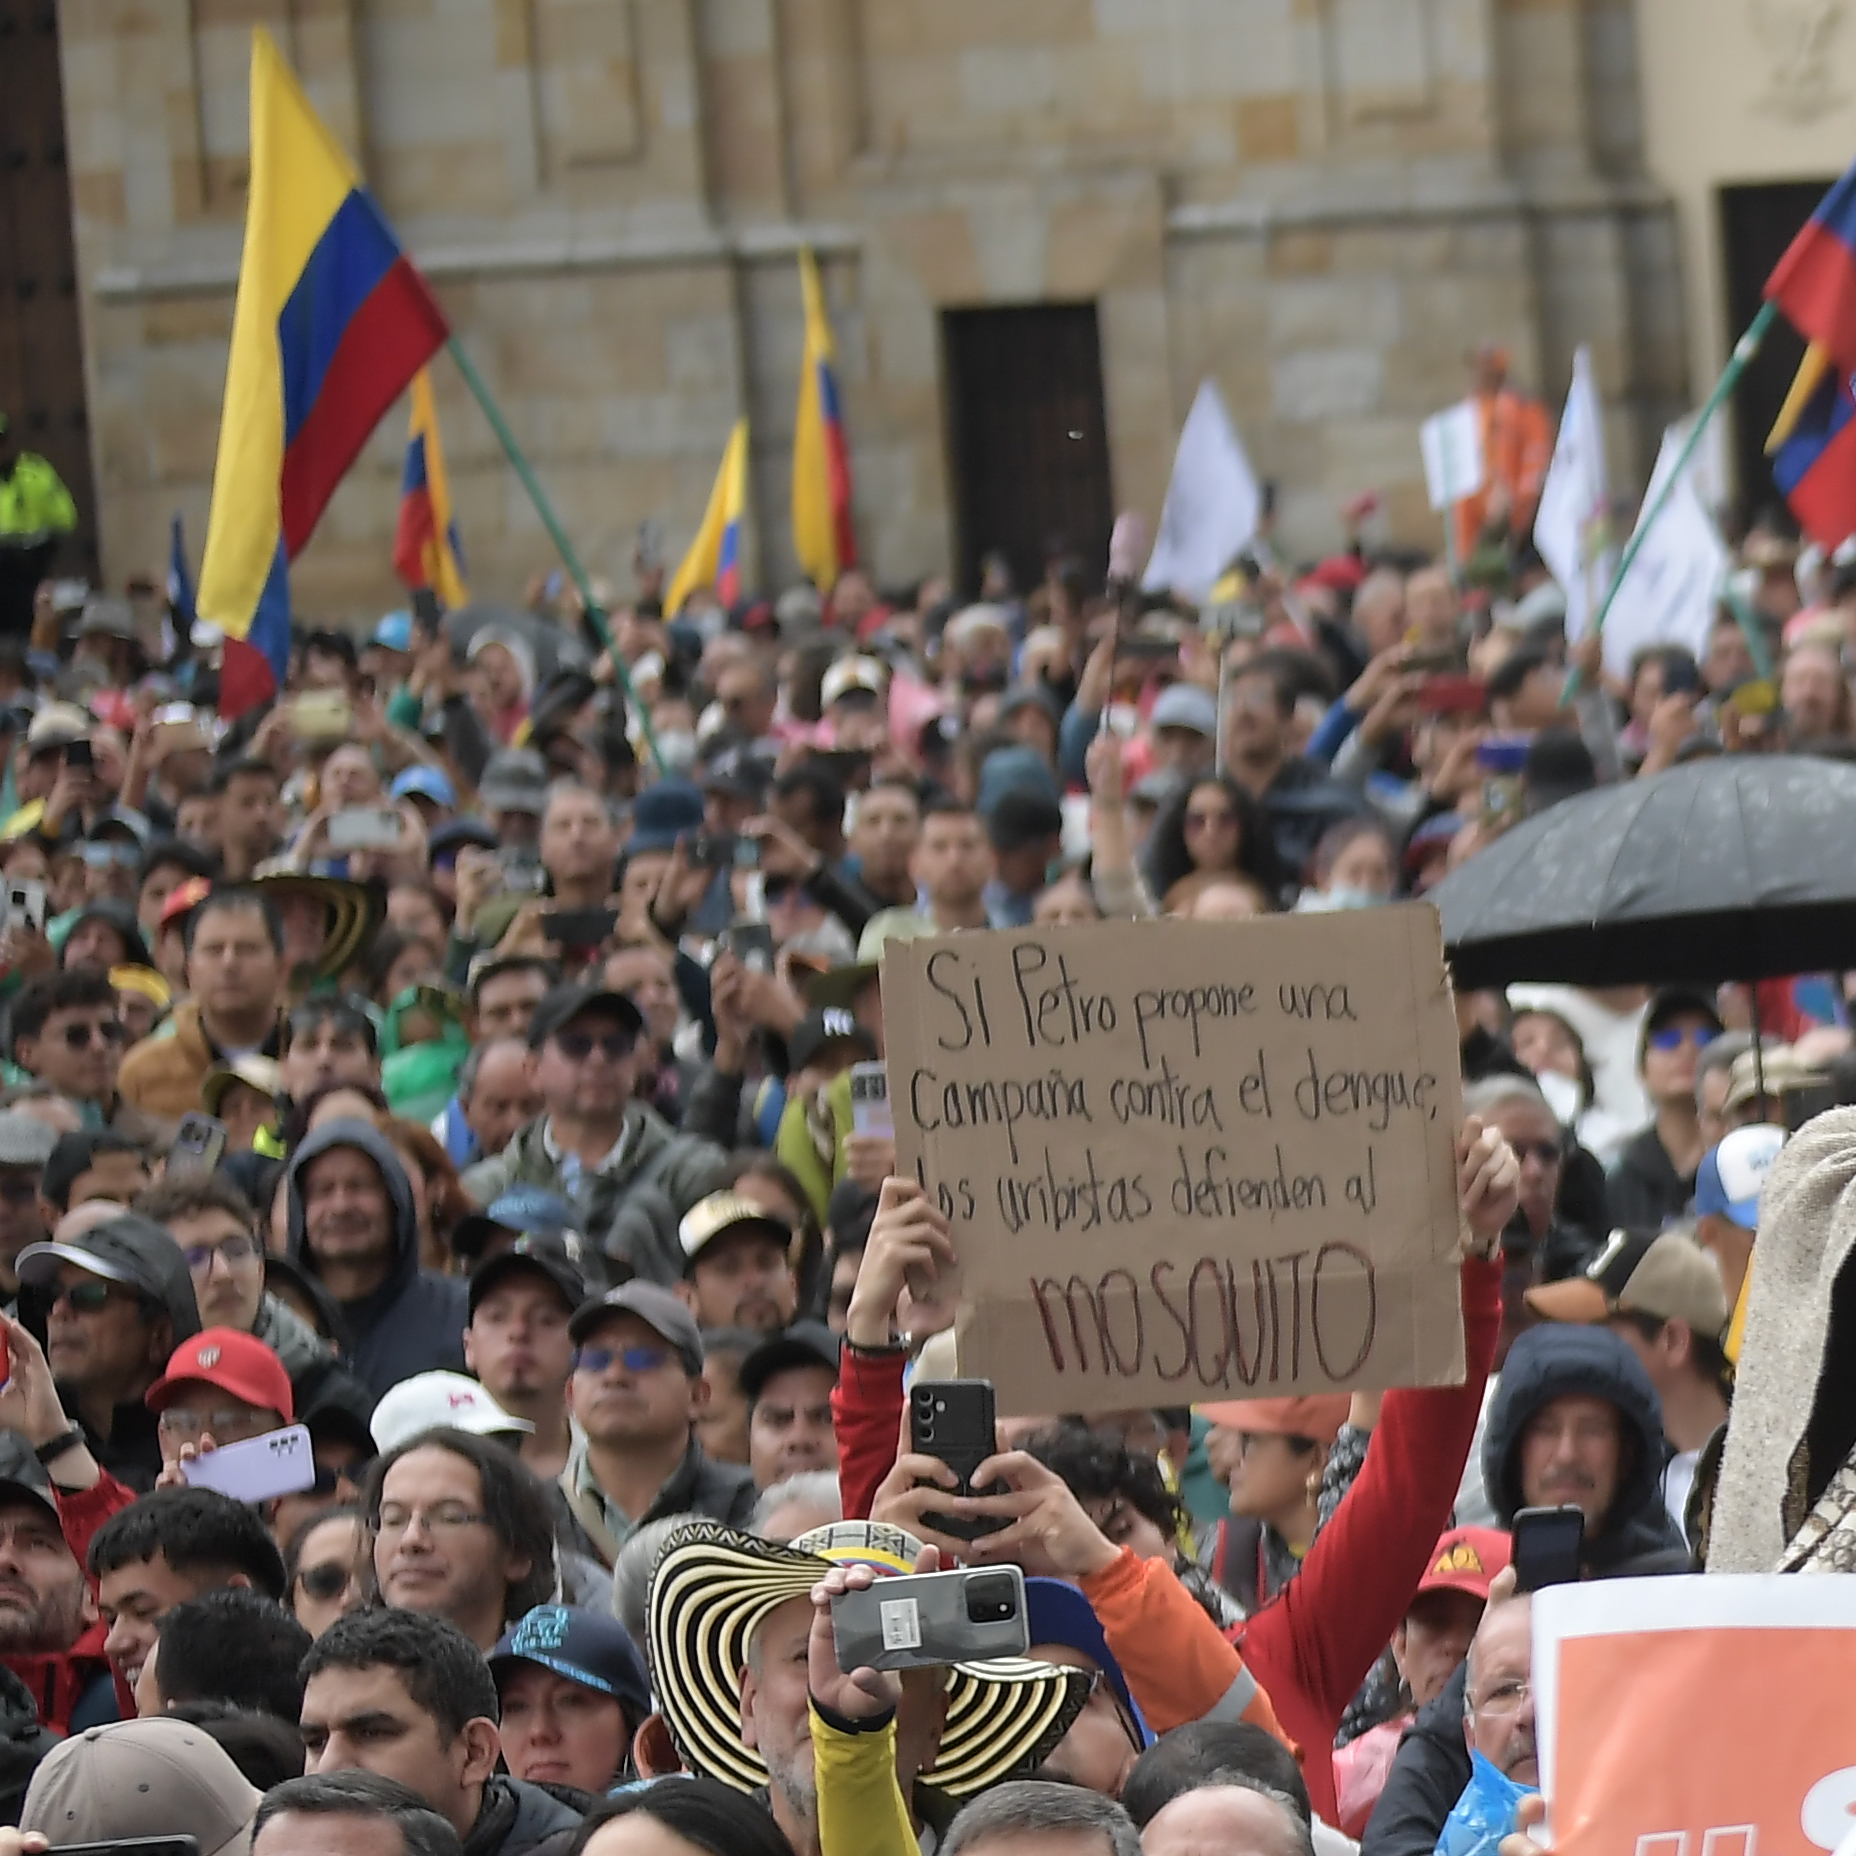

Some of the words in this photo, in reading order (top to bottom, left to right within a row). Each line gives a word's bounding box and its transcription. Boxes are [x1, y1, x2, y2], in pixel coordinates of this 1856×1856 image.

[926, 949, 992, 1051] Si
[1011, 942, 1118, 1047] Petro
[1133, 982, 1257, 1070] propone
[1278, 982, 1357, 1022] una
[1109, 1055, 1224, 1132] contra
[1238, 1048, 1273, 1118] el
[997, 1146, 1153, 1234] uribistas
[1170, 1144, 1327, 1218] defienden
[1344, 1146, 1377, 1215] al
